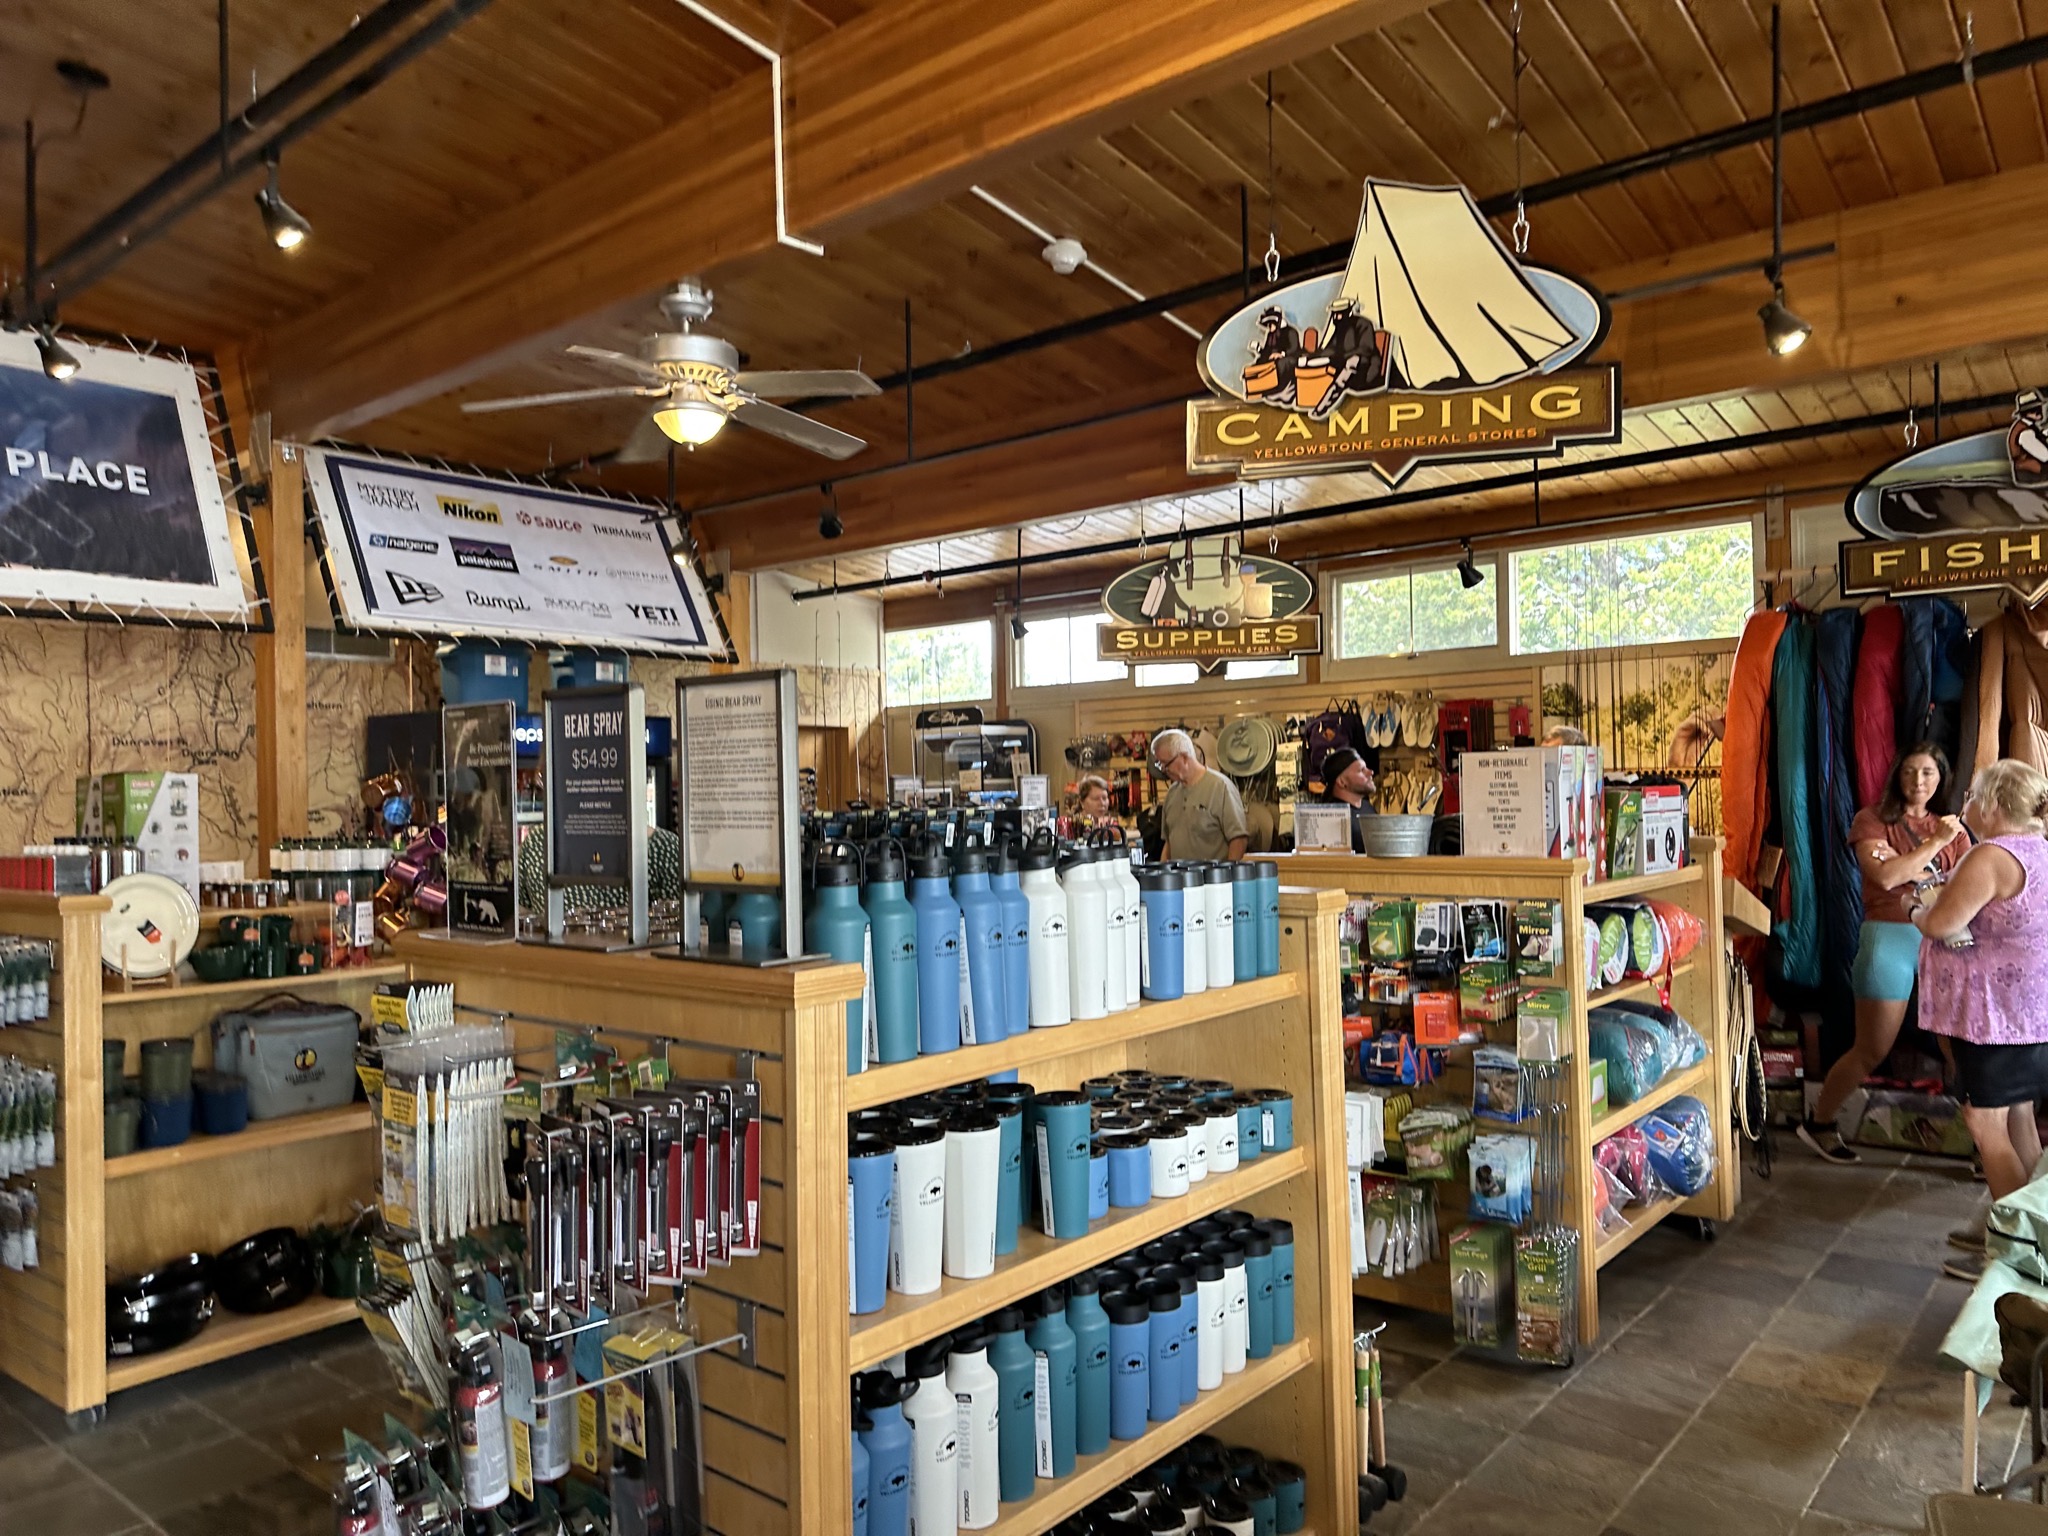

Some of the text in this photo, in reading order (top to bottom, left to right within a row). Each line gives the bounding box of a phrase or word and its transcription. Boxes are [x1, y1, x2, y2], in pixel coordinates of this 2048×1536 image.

[1216, 385, 1582, 446] CAMPING
[1254, 427, 1538, 460] YELLOWSTONE GENERAL STORES
[5, 447, 150, 496] PLACE
[357, 481, 415, 498] MYSTERY
[370, 496, 420, 512] RANCH
[443, 501, 499, 524] Nikon
[534, 515, 583, 533] sauce
[389, 537, 434, 551] nalgene
[459, 554, 514, 570] patagonia
[1873, 534, 2041, 577] FISH
[1902, 568, 2011, 587] YELLOWSTONE
[466, 590, 531, 614] Rumpl
[626, 604, 679, 621] YETI
[1116, 624, 1299, 650] SUPPLIES
[1134, 648, 1198, 657] YELLOWSTONE
[1201, 646, 1243, 655] GENERAL
[564, 711, 623, 739] BEAR SPRAY
[512, 727, 544, 745] eps
[572, 747, 618, 771] $54.99
[1478, 758, 1529, 768] NON-RETURNABLE
[1494, 770, 1512, 780] ITEMS
[1519, 925, 1550, 935] Mirror
[1527, 1002, 1550, 1010] Mirror
[720, 1091, 727, 1100] 75
[746, 1084, 755, 1092] 75
[668, 1104, 677, 1113] 75
[695, 1098, 704, 1107] 75
[1527, 1263, 1547, 1272] Grill
